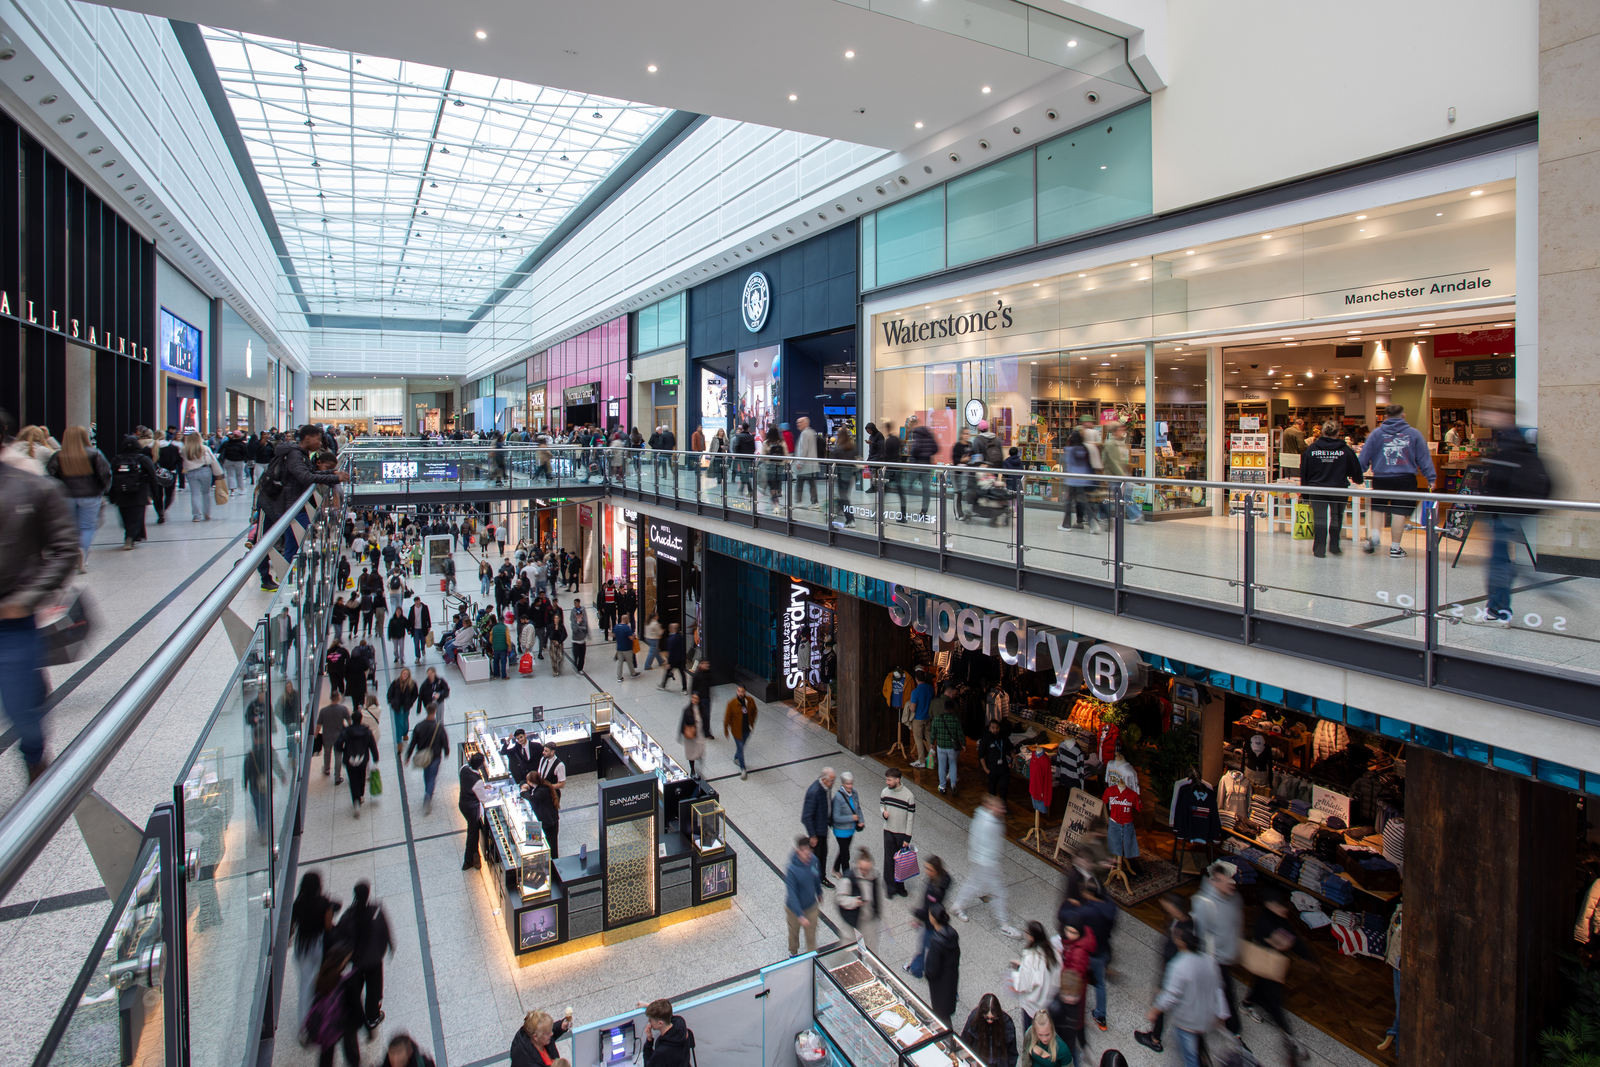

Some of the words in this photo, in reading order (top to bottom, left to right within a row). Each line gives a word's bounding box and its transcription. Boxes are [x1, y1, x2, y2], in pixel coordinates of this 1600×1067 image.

[1344, 285, 1426, 306] Manchester
[1430, 277, 1492, 295] Arndale
[0, 290, 150, 363] ALLSAINTS
[882, 300, 1014, 347] Waterstone's
[1434, 377, 1451, 386] PLEASE
[313, 398, 363, 411] NEXT
[660, 525, 671, 533] HOTEL
[609, 792, 650, 807] SUNNAMUSK
[1076, 793, 1096, 808] VINTAGE
[1317, 798, 1343, 812] Athletic
[1314, 801, 1347, 820] Essentials
